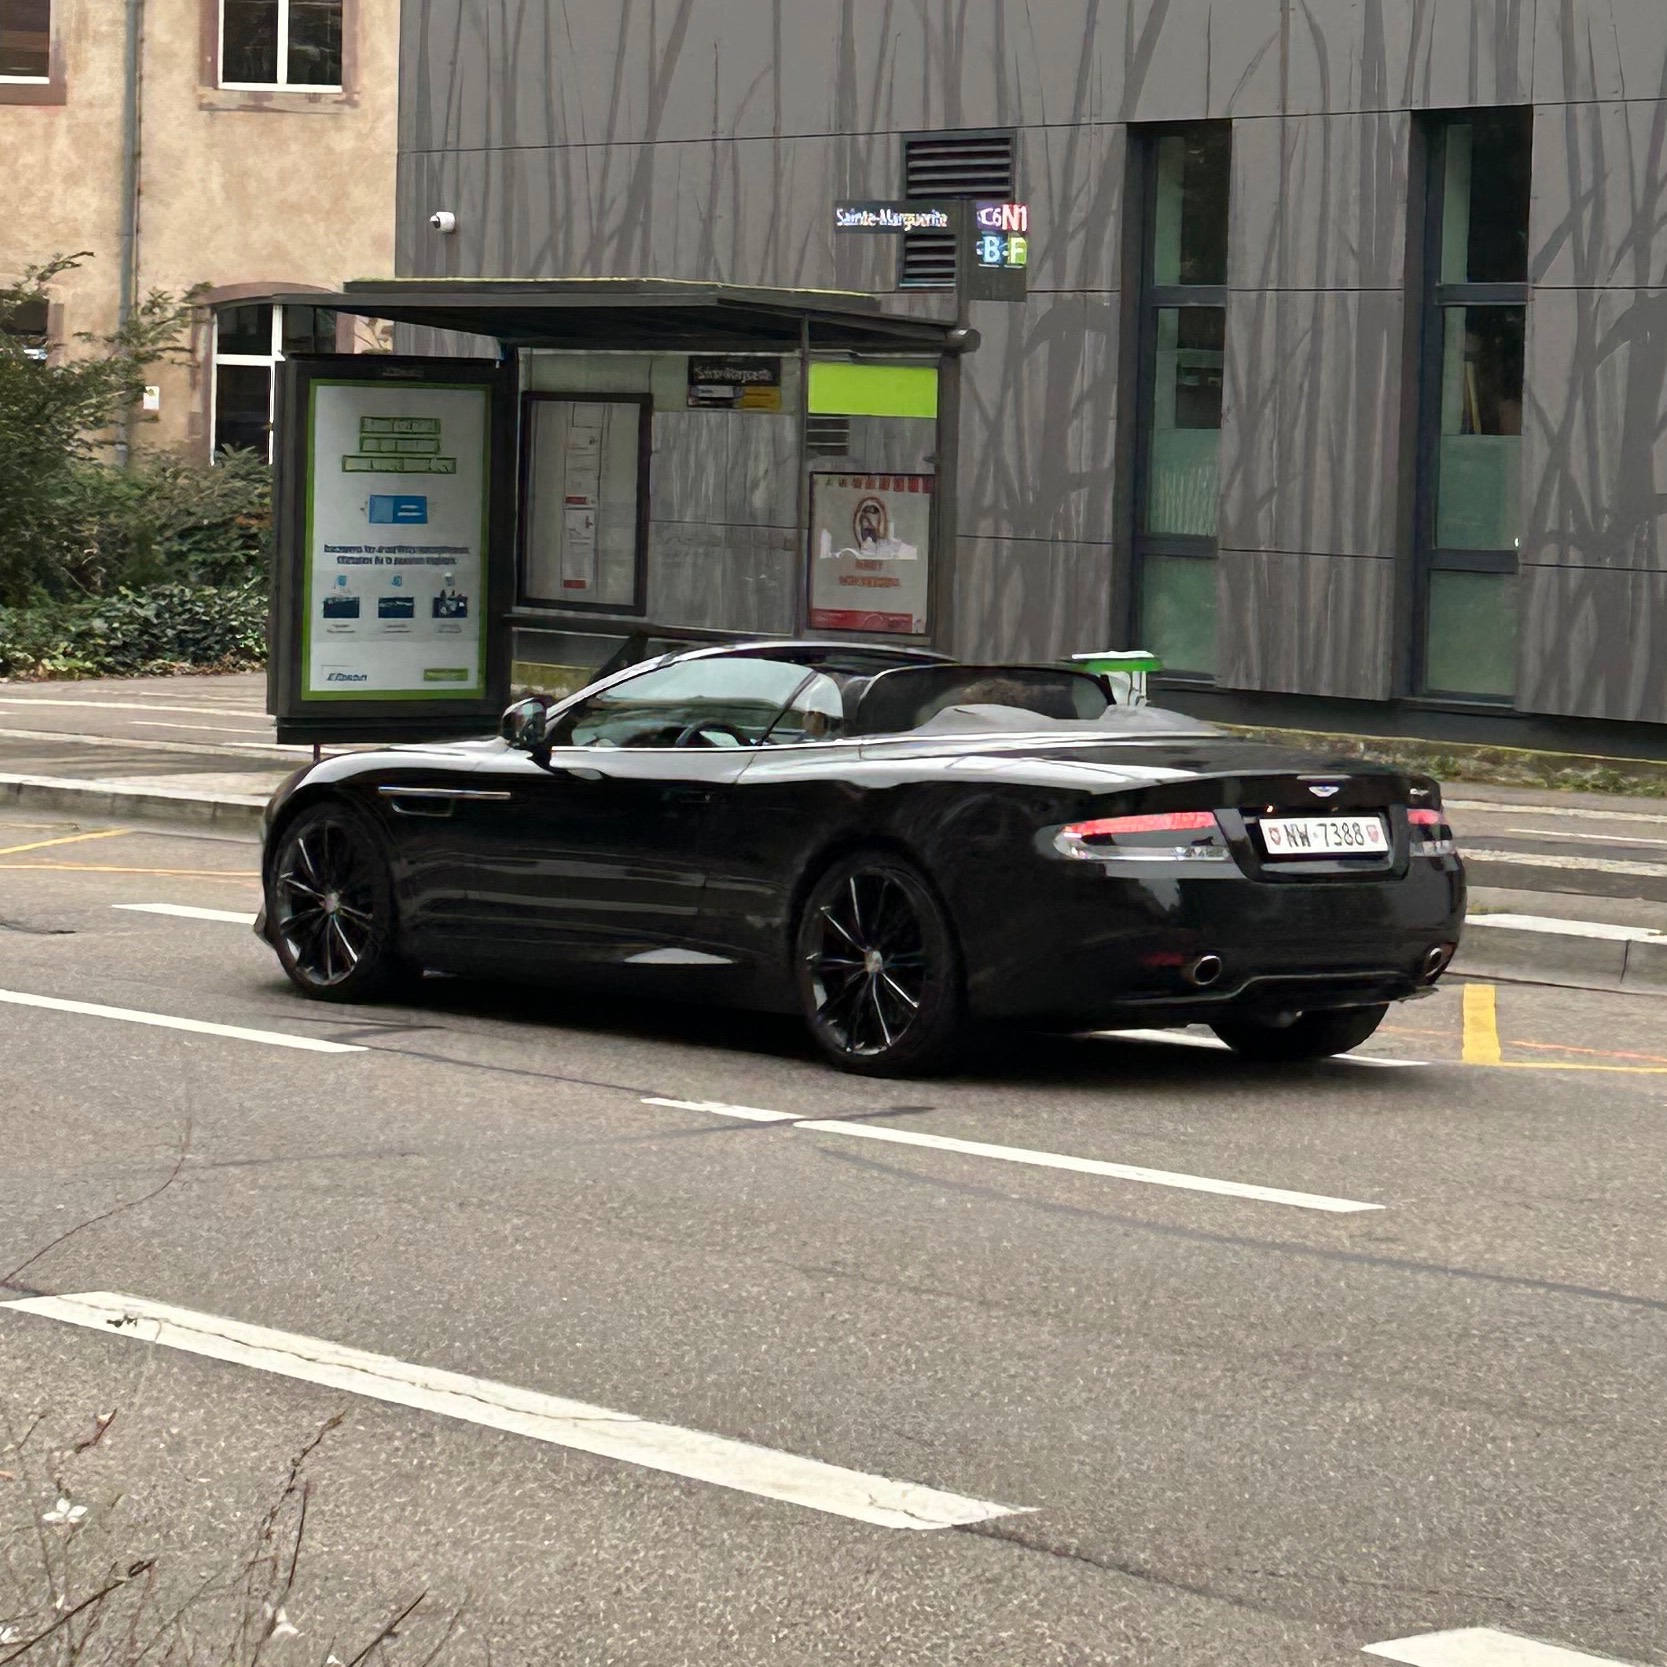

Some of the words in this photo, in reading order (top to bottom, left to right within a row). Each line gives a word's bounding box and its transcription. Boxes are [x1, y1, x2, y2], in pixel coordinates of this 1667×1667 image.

[836, 207, 948, 231] Sainte-Marguerite
[1002, 204, 1028, 231] N1
[984, 236, 999, 263] B
[1010, 238, 1026, 264] F
